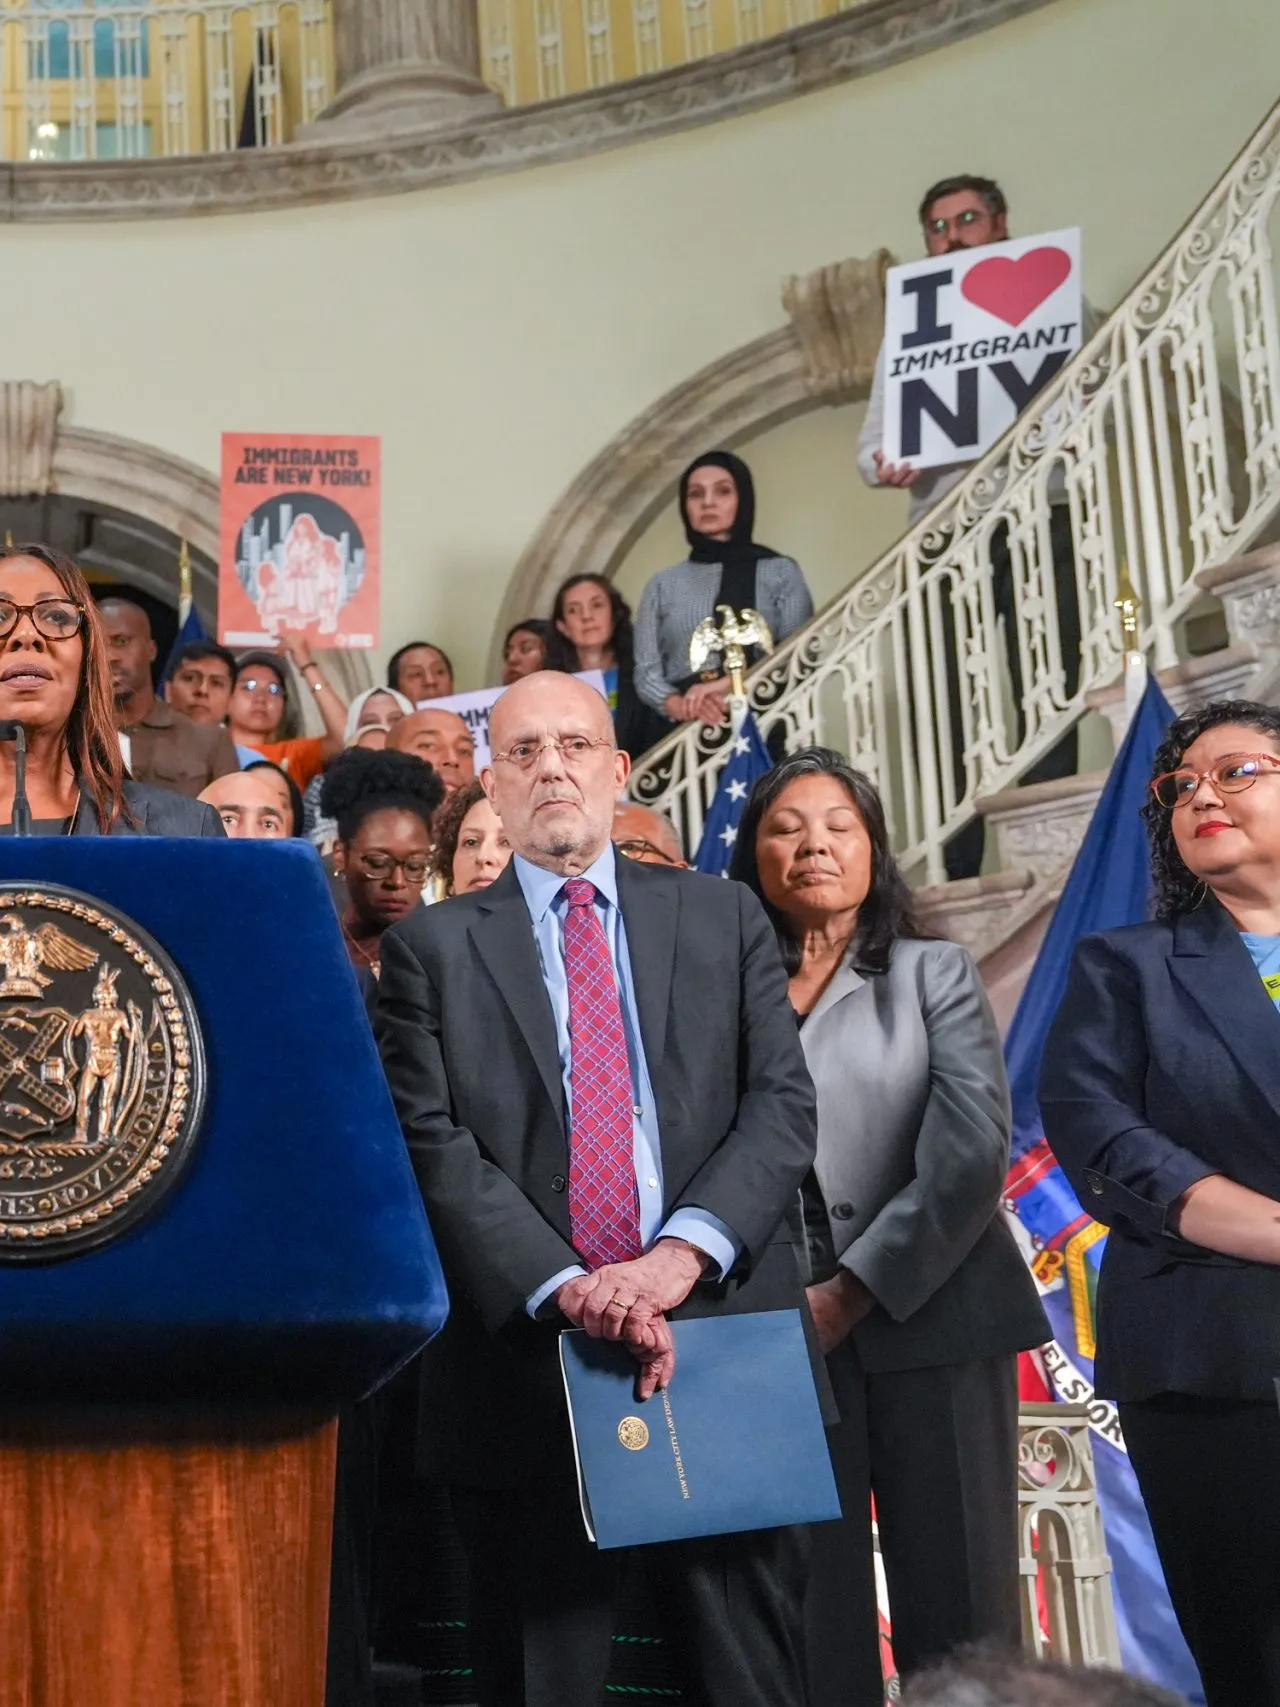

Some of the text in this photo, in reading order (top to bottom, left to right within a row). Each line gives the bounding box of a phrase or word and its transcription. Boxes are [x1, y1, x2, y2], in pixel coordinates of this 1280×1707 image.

[901, 268, 953, 350] I
[889, 323, 1078, 377] IMMIGRANT
[900, 349, 1073, 459] NY
[235, 467, 372, 486] ARE NEW YORK!
[243, 447, 358, 466] IMMIGRANTS
[661, 1388, 690, 1499] NEW YORK CITY LAW DEPAR
